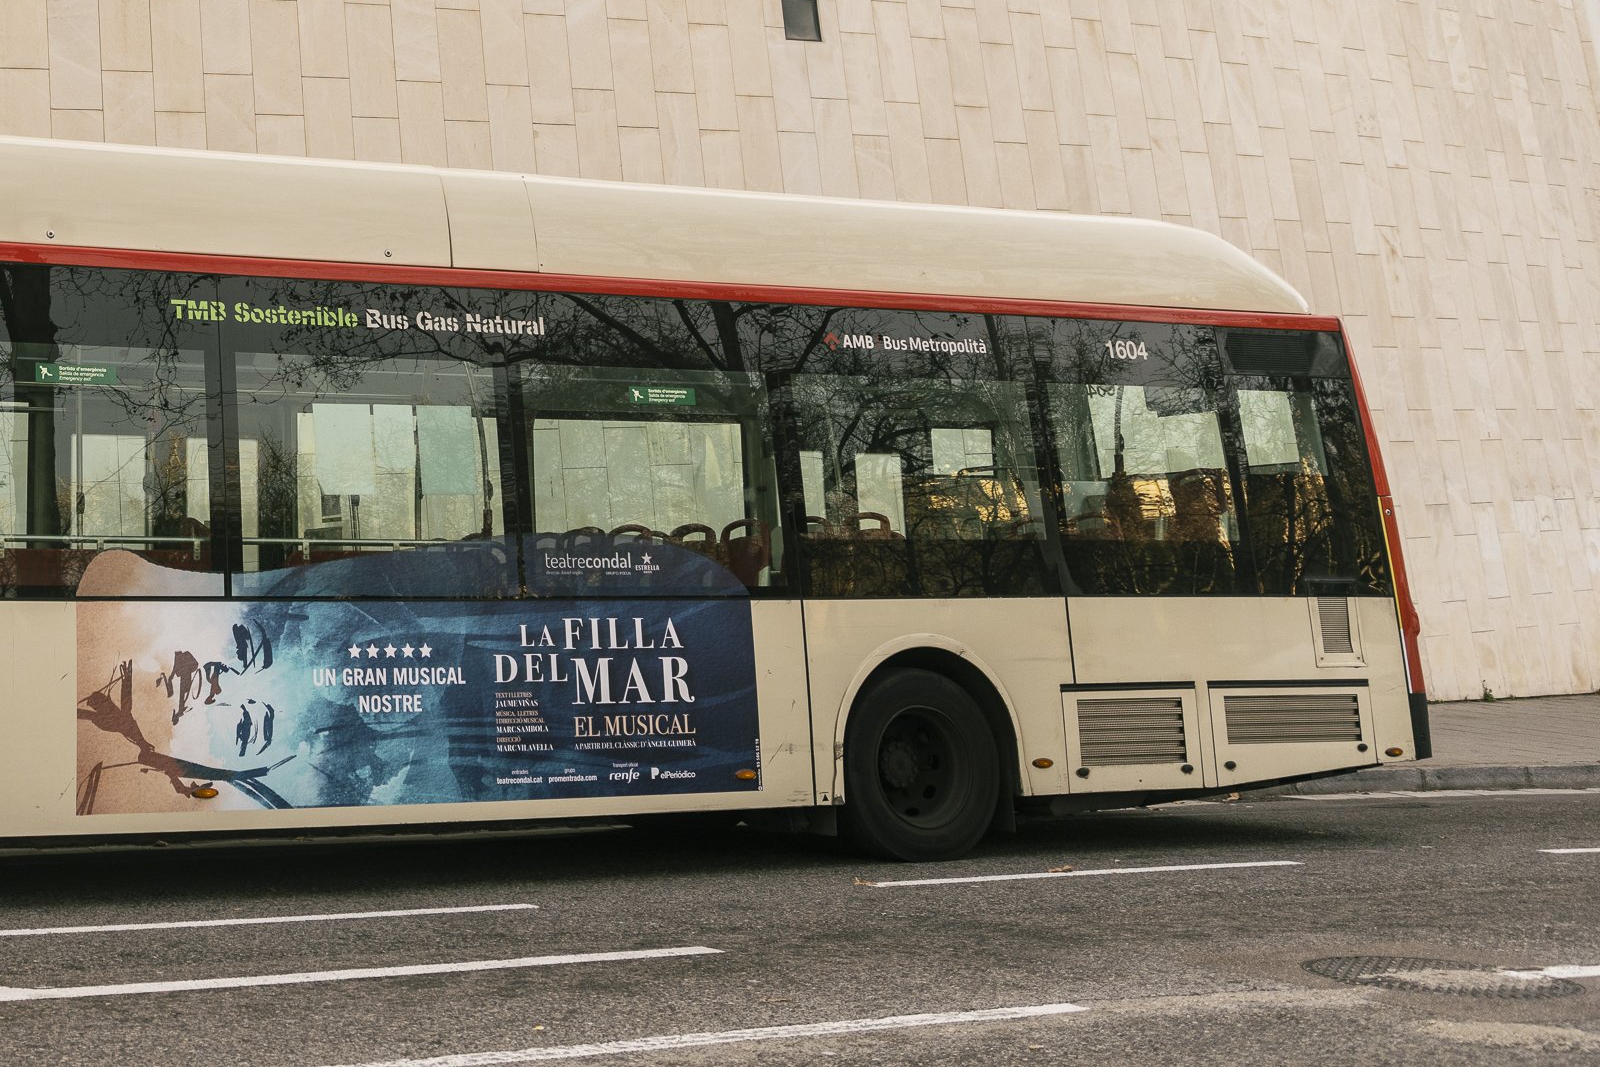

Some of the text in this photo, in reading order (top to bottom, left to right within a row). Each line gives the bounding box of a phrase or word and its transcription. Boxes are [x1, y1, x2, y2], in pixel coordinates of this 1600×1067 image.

[171, 299, 545, 336] TMB Sostenible Bus Gas Natural
[843, 334, 987, 355] AMB Bus Metropolità
[1105, 340, 1148, 360] 1604
[545, 552, 631, 569] teatrecondal
[520, 617, 684, 650] LA FILLA
[313, 666, 466, 687] UN GRAN MUSICAL
[493, 653, 695, 705] DEL MAR
[359, 694, 423, 713] NOSTRE
[495, 698, 538, 708] JAUME VIÑAS
[496, 725, 549, 733] MARC SAMBOLA
[574, 713, 696, 738] EL MUSICAL
[496, 743, 554, 752] MARC VILAVELLA
[580, 742, 600, 750] PARTIR
[601, 741, 614, 749] DEL
[614, 740, 640, 749] CLÀSSIC
[496, 776, 543, 785] teatrecondal.cat
[548, 774, 598, 784] promentrada.com
[609, 768, 640, 784] renfe
[660, 770, 696, 779] elPeriódico
